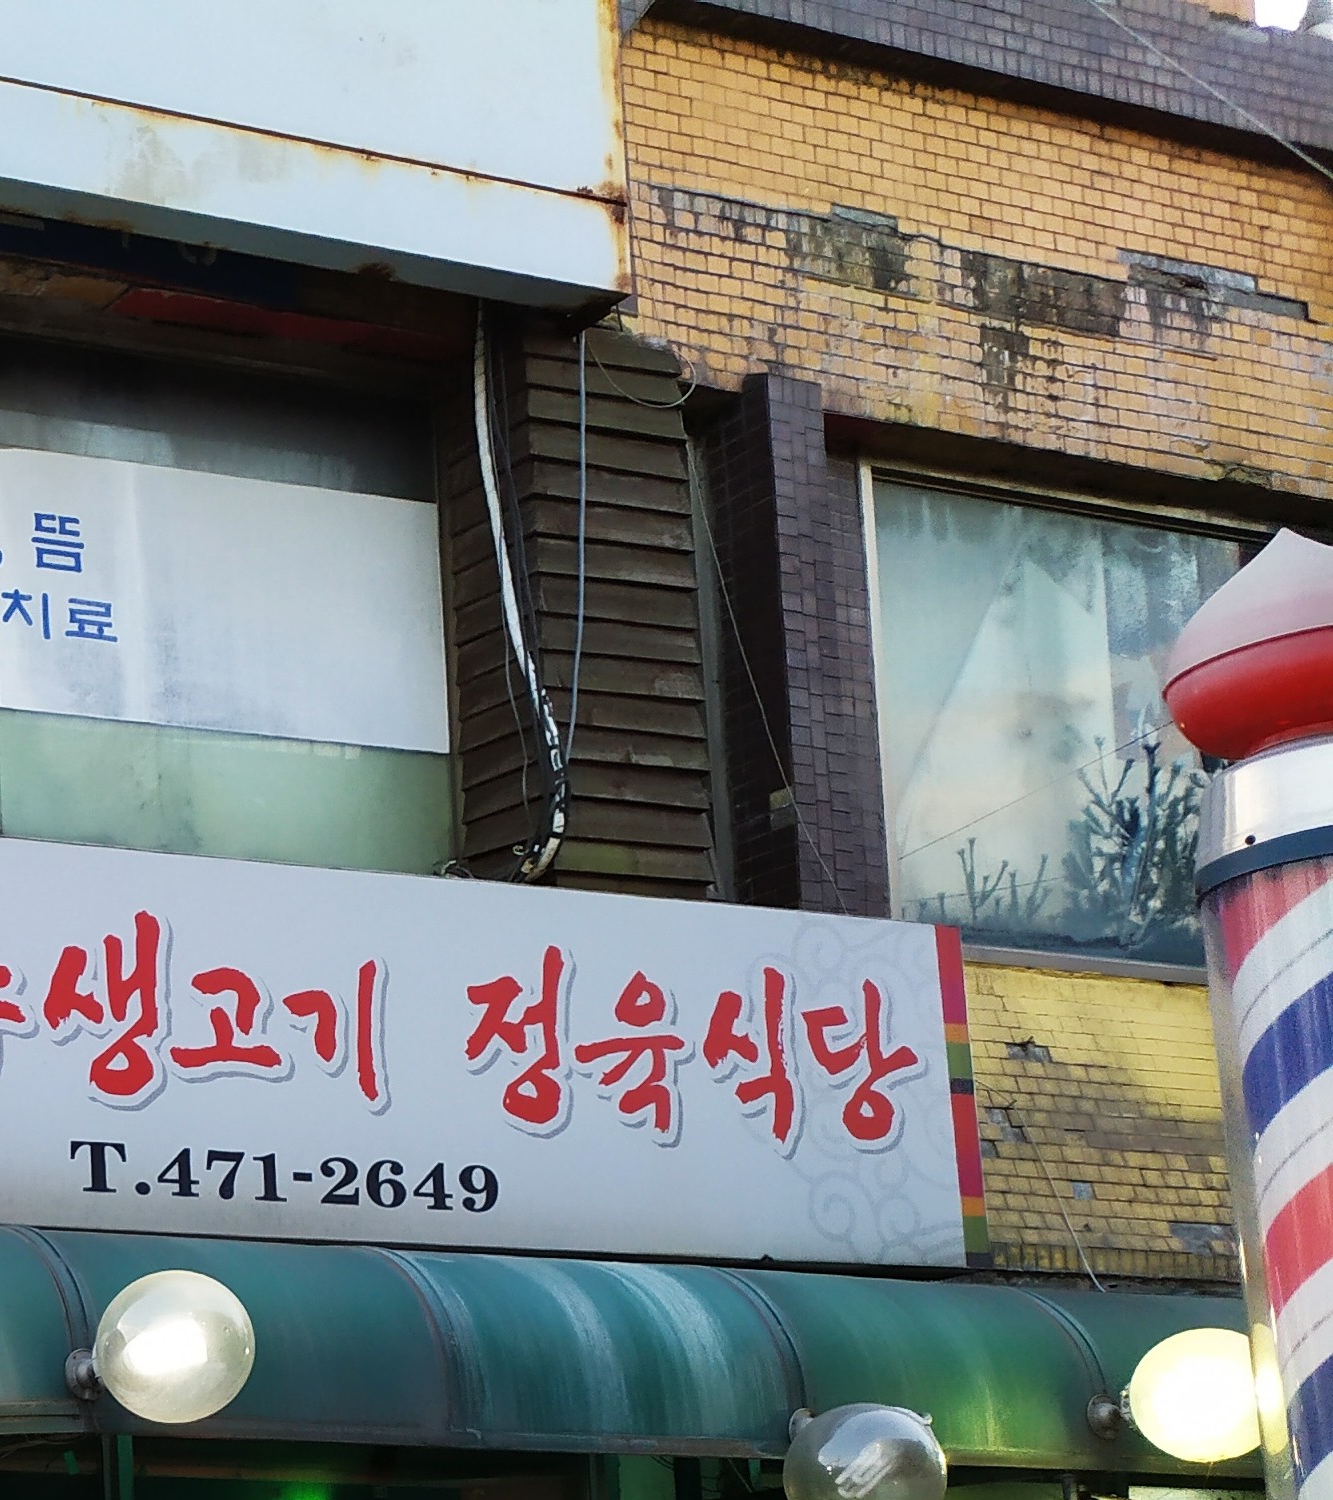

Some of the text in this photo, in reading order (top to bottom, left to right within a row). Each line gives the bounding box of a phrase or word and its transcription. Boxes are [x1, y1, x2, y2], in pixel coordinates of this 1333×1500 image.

[31, 512, 85, 573] 뜸
[463, 944, 923, 1143] 정육식당
[70, 1139, 500, 1213] T.471-2649
